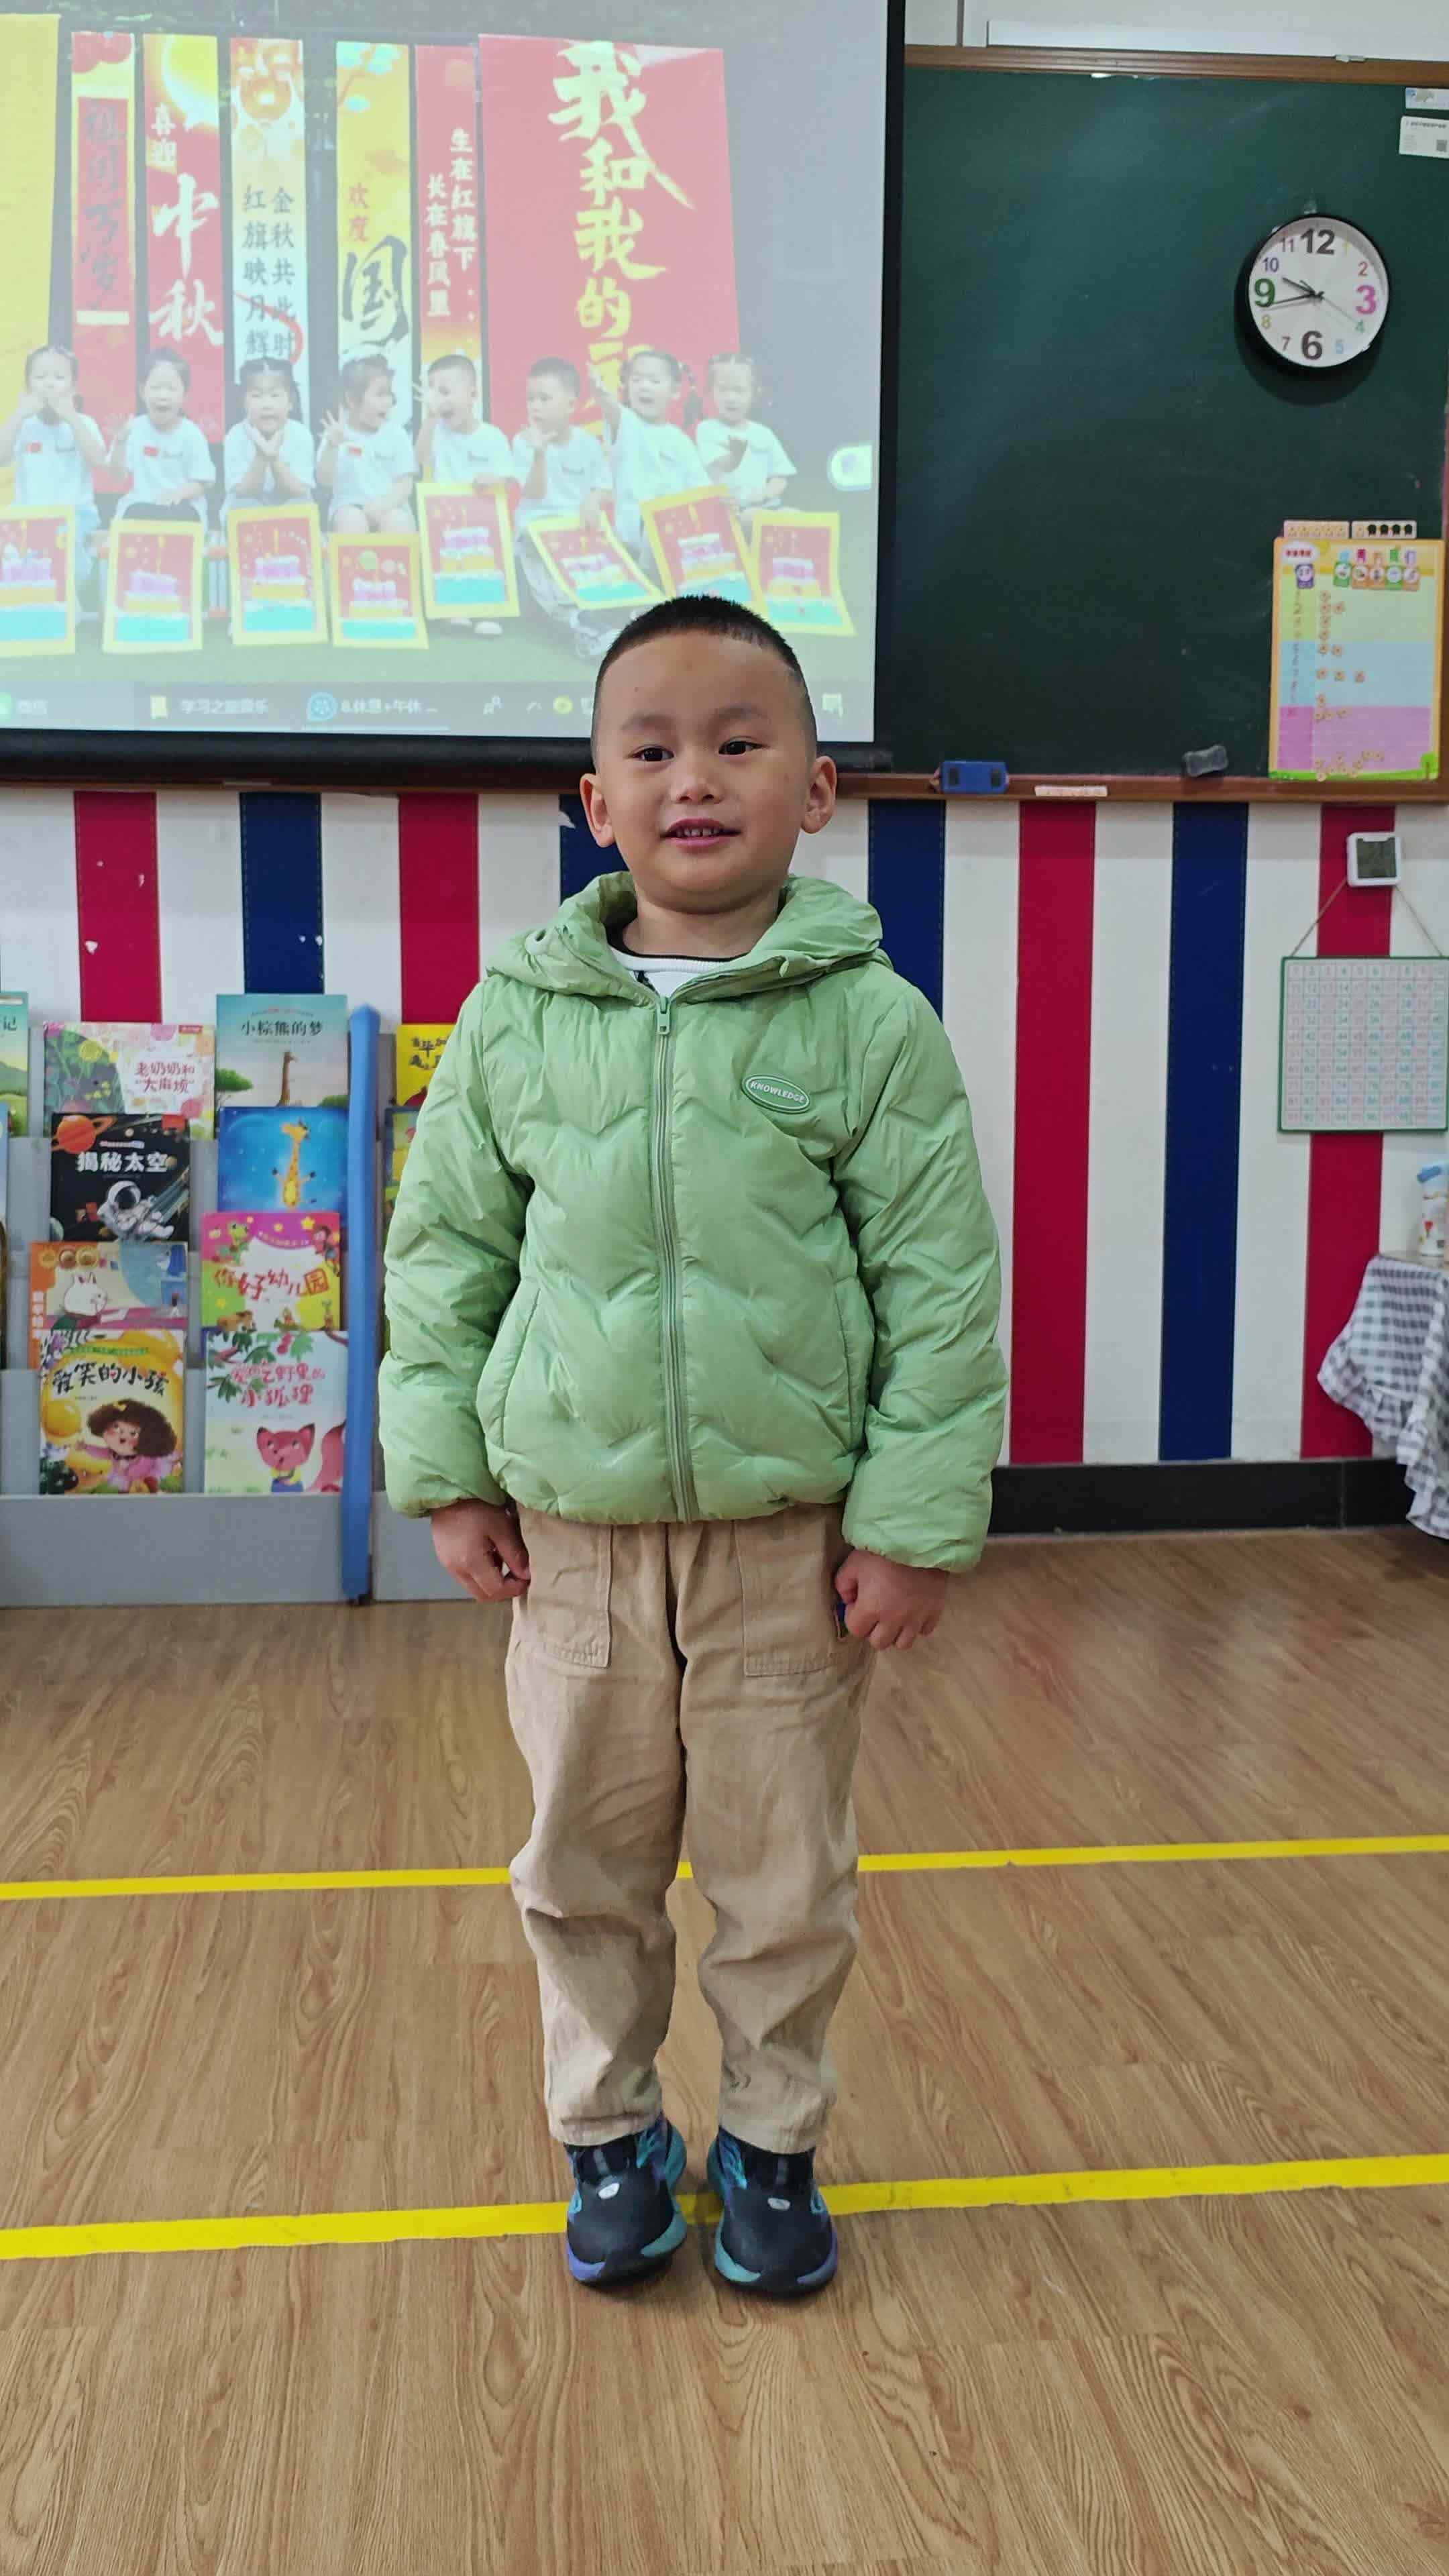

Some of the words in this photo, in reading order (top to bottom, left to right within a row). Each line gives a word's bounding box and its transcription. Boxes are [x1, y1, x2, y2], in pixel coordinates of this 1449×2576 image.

[449, 127, 478, 271] 生在红旗下
[1281, 237, 1294, 253] 11
[1300, 228, 1335, 255] 12
[148, 172, 224, 345] 中秋
[1263, 257, 1280, 272] 10
[1358, 261, 1369, 276] 2
[341, 233, 411, 348] 国
[1254, 278, 1275, 308] 9
[1355, 284, 1377, 315] 3
[1261, 315, 1271, 329] 8
[1355, 319, 1365, 333] 4
[1281, 336, 1291, 351] 7
[1301, 330, 1323, 360] 6
[1335, 339, 1344, 355] 5
[3, 1016, 17, 1032] 记
[241, 1020, 323, 1036] 小棕熊的梦
[136, 1061, 195, 1077] 老奶奶和
[750, 1080, 806, 1104] KNOWLEDGE
[76, 1151, 168, 1173] 揭秘太空
[213, 1267, 330, 1301] 你好幼儿园
[240, 1383, 314, 1408] 小狐狸
